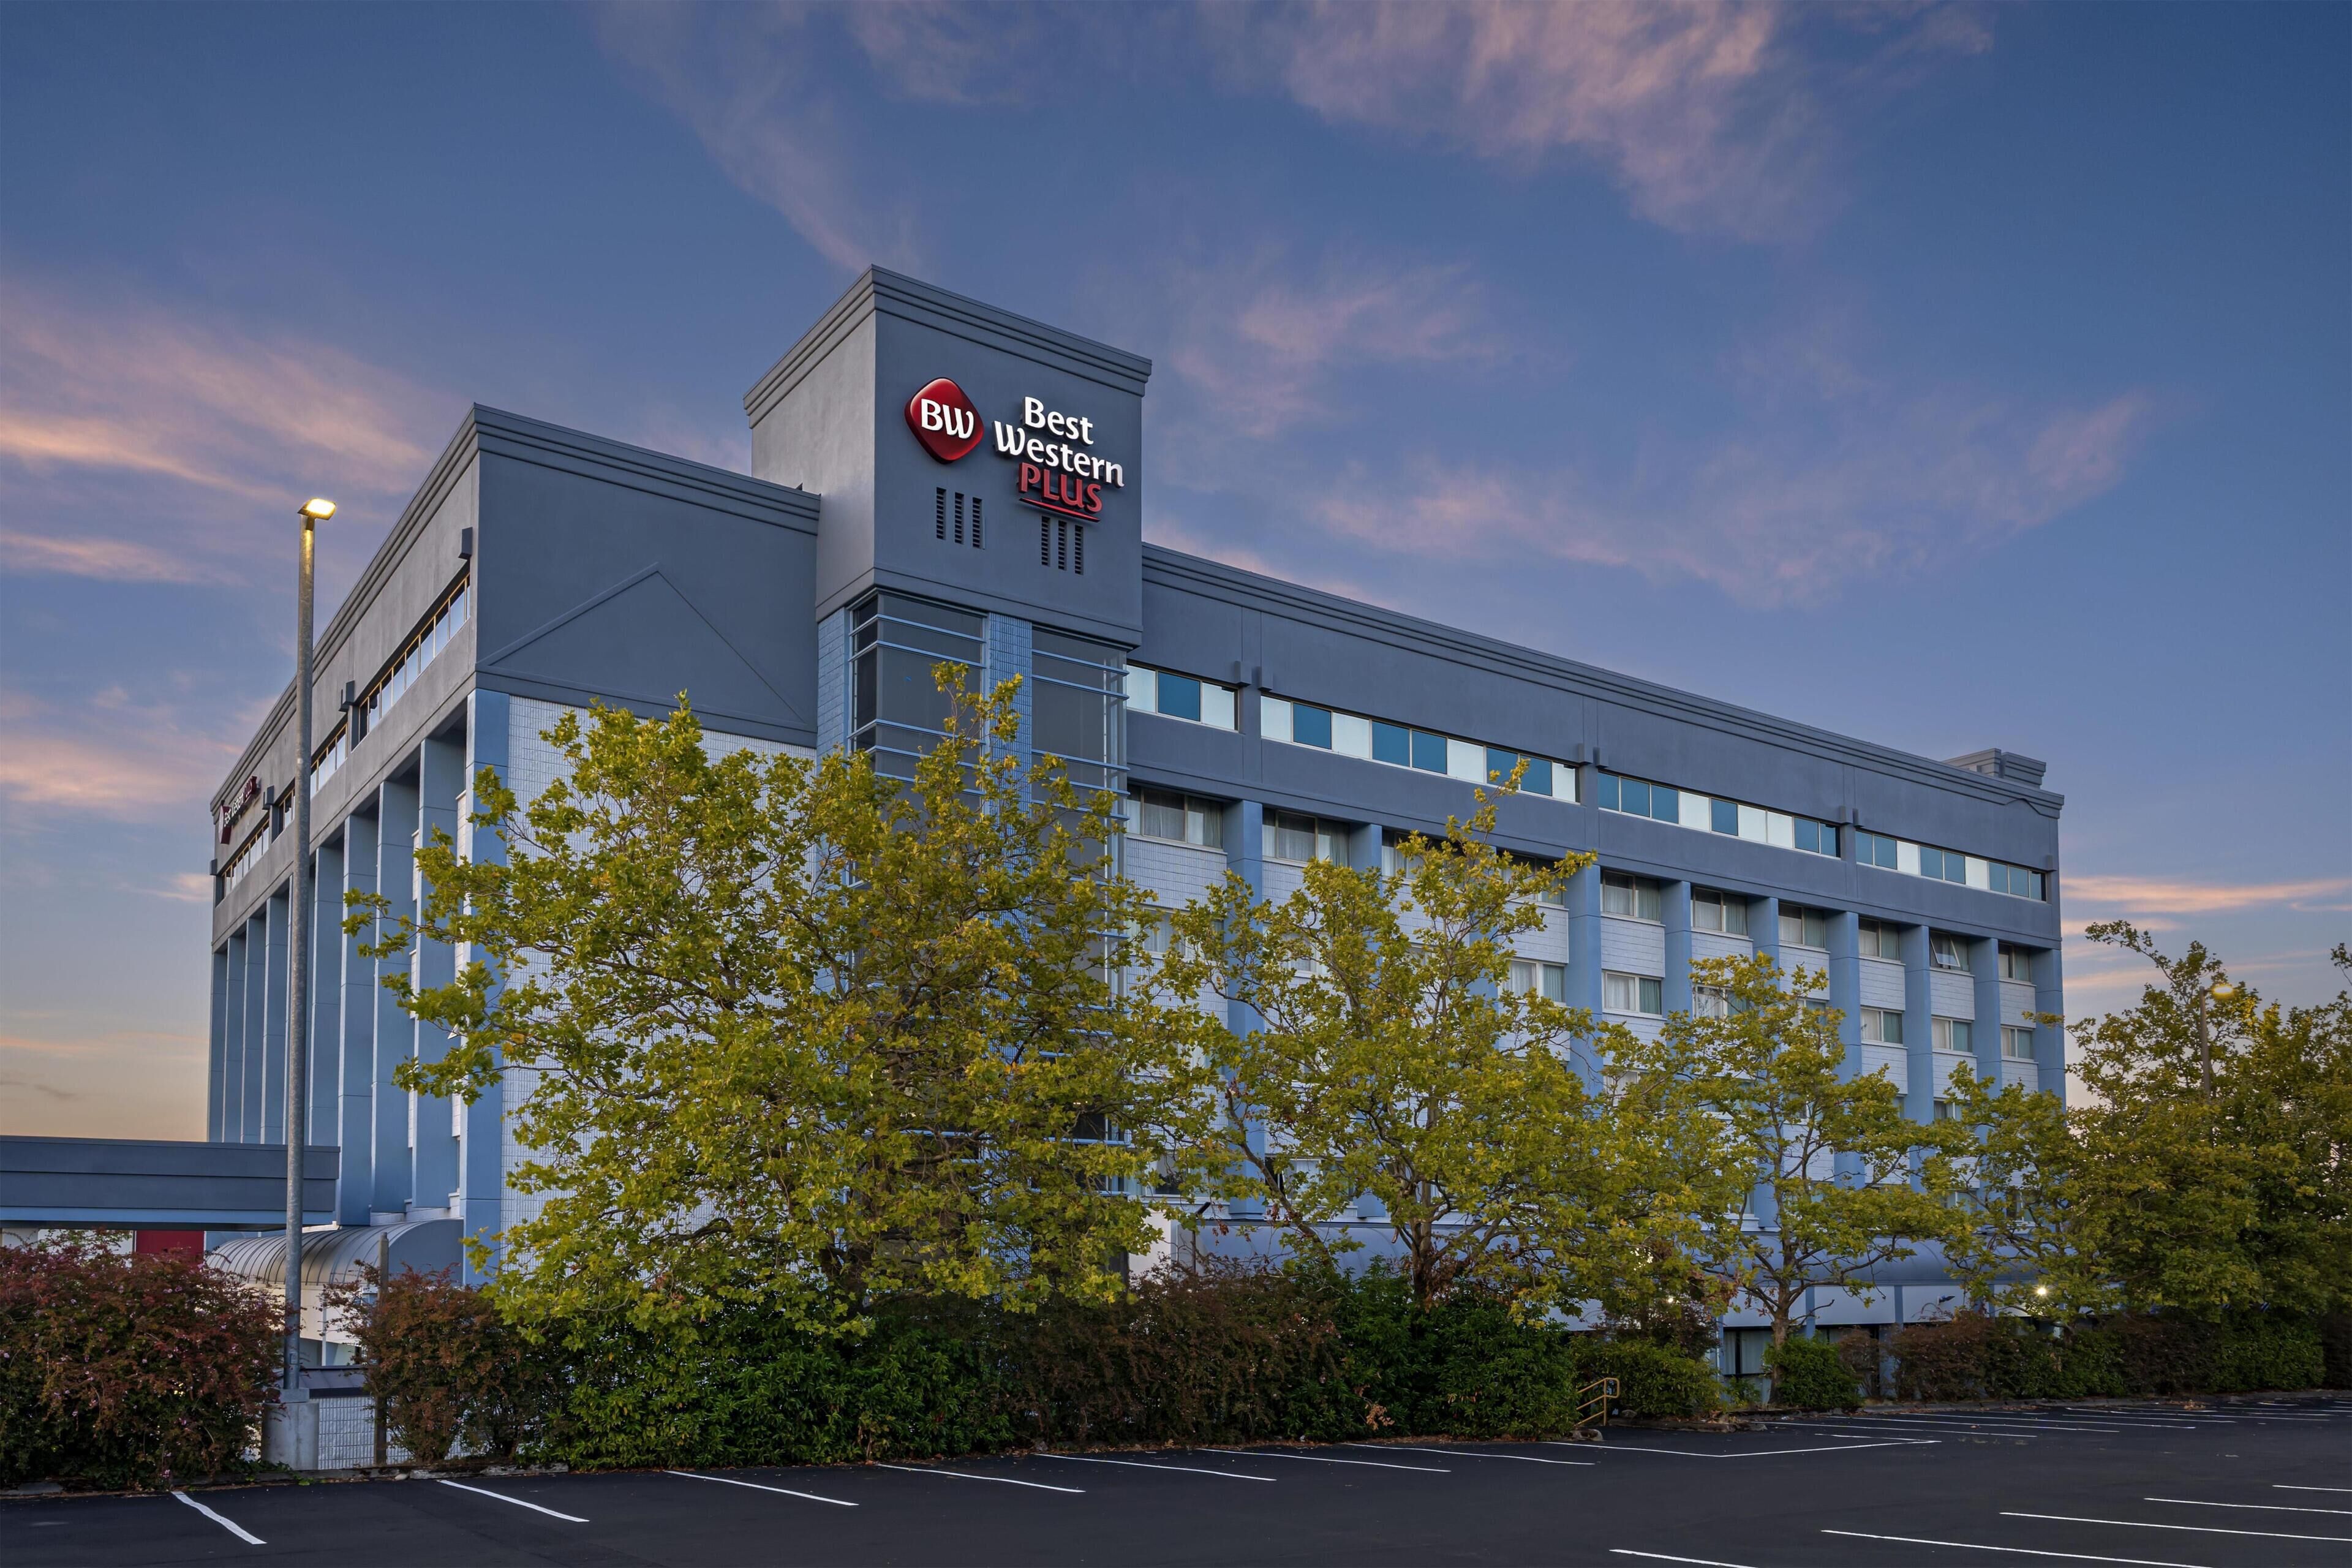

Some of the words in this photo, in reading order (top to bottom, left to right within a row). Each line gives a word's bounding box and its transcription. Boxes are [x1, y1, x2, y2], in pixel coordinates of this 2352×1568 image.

[921, 398, 974, 439] BW
[1023, 396, 1094, 445] Best
[993, 420, 1125, 487] Western
[1019, 462, 1102, 513] PLUS
